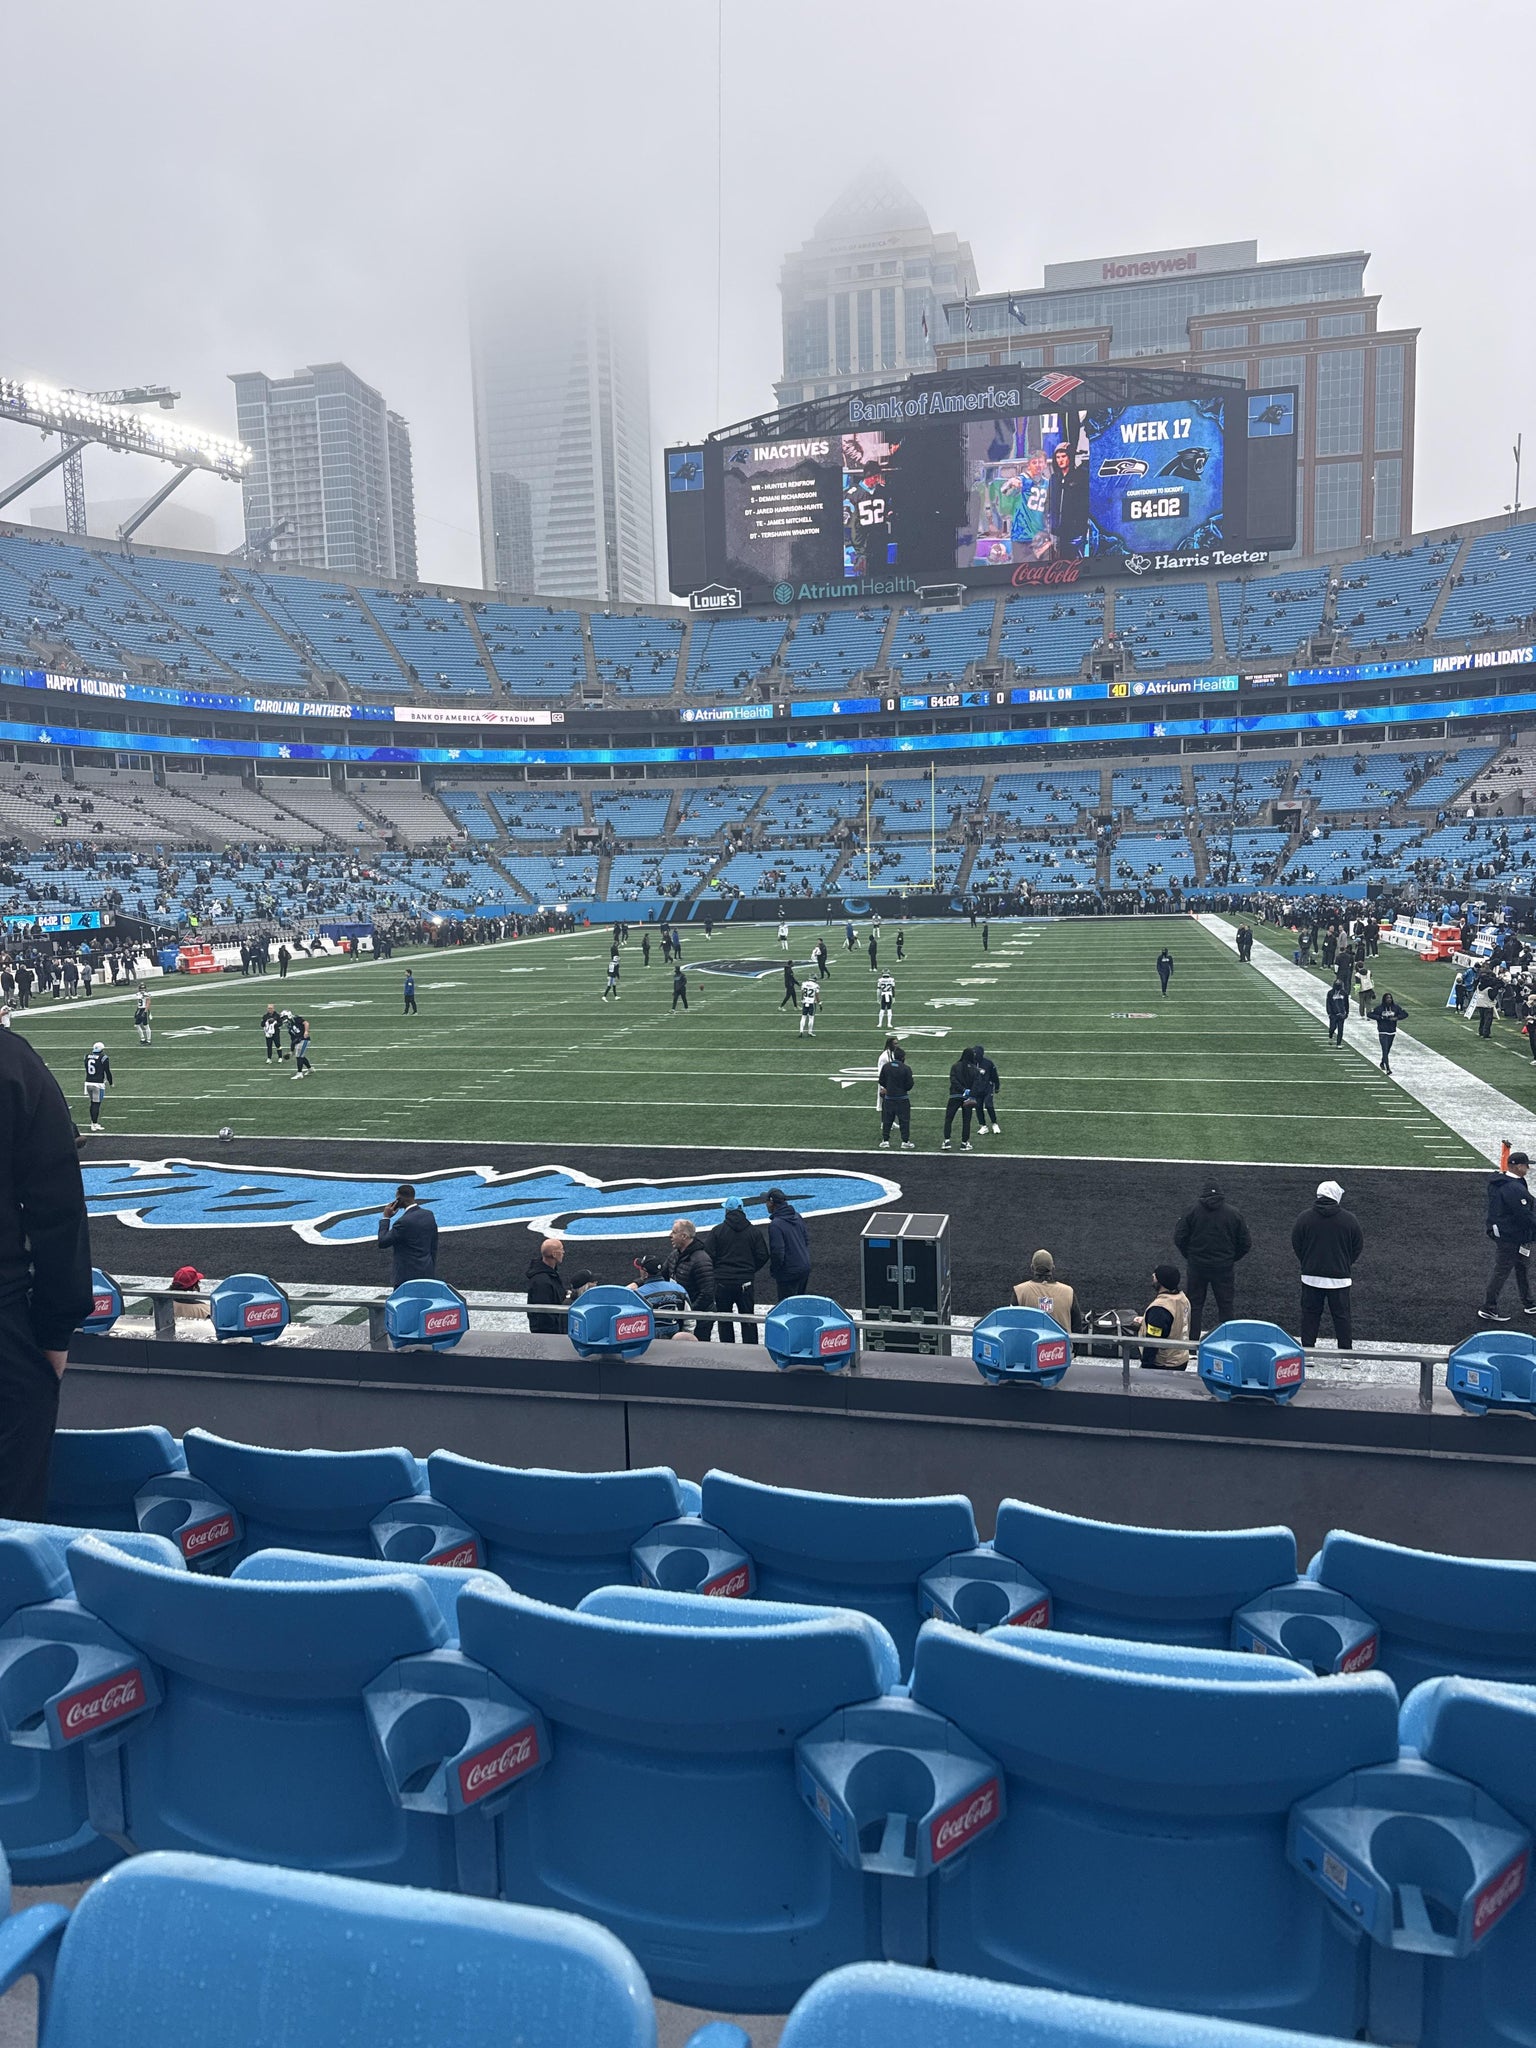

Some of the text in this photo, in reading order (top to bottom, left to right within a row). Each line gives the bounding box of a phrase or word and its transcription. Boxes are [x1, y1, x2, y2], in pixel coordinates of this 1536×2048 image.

[1102, 253, 1197, 279] Honeywell
[849, 386, 1020, 421] Bank of America
[1120, 418, 1192, 443] WEEK 17
[754, 442, 829, 461] INACTIVES
[765, 482, 787, 490] HUNTER
[781, 492, 817, 500] RICHARDSON
[1027, 486, 1048, 512] 22
[756, 507, 774, 515] JARED
[858, 499, 885, 526] 52
[1130, 498, 1180, 519] 64:02
[786, 516, 813, 524] MITCHELL
[1155, 550, 1268, 570] Harris Teeter
[1011, 559, 1084, 587] Coca-Cola
[798, 576, 916, 600] Atrium Health
[694, 593, 736, 608] LOWE'S
[1433, 647, 1533, 673] HAPPY HOLIDAYS
[45, 674, 127, 698] HAPPY HOLIDAYS
[1111, 684, 1127, 696] 40
[1145, 678, 1235, 694] Atrium Health
[930, 695, 960, 707] 64:02
[996, 692, 1005, 704] 0
[1029, 688, 1072, 702] BALL ON
[253, 699, 352, 718] CAROLINA PANTHERS
[887, 699, 895, 711] 0
[445, 714, 480, 722] AMERICA
[694, 706, 771, 721] Atrium Health
[881, 984, 892, 992] 22
[87, 1059, 97, 1075] 6
